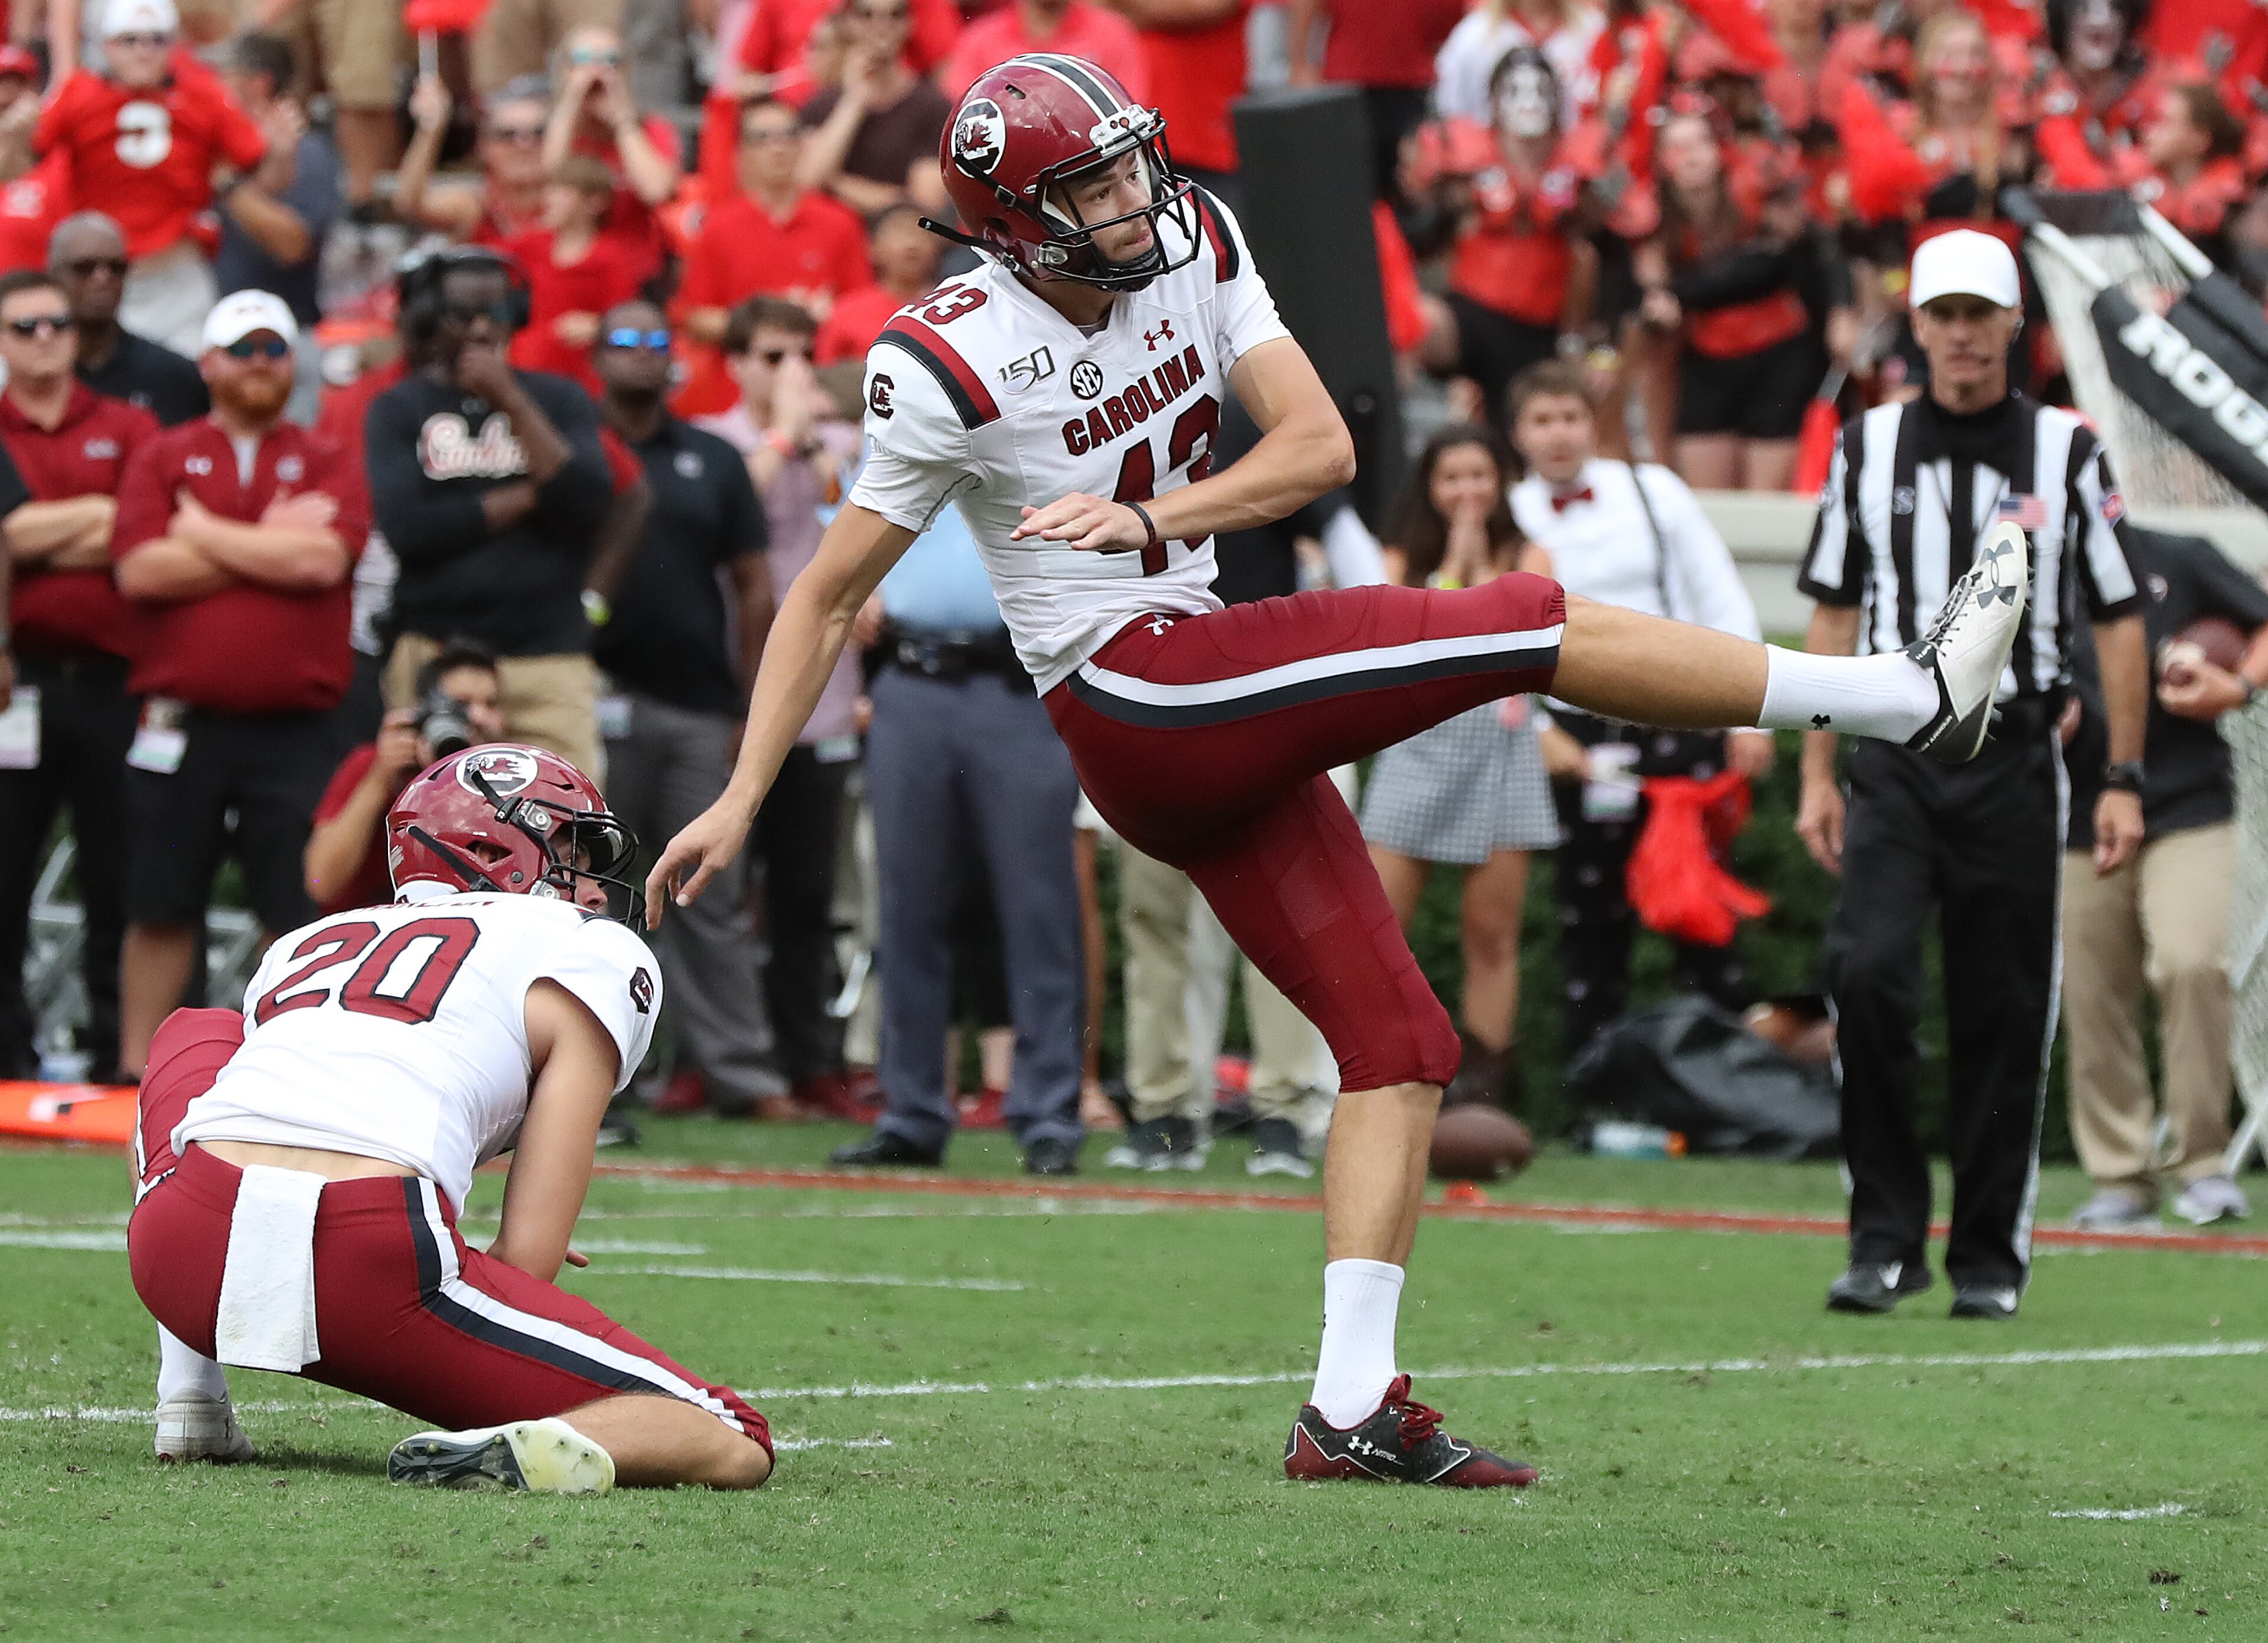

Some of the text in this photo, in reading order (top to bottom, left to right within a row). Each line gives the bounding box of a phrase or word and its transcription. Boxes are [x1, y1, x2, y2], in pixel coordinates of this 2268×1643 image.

[995, 346, 1056, 395] 150
[1061, 343, 1205, 457] CAROLINA
[1071, 361, 1103, 399] SEC
[2117, 312, 2268, 468] ROG
[255, 917, 481, 1028] 20
